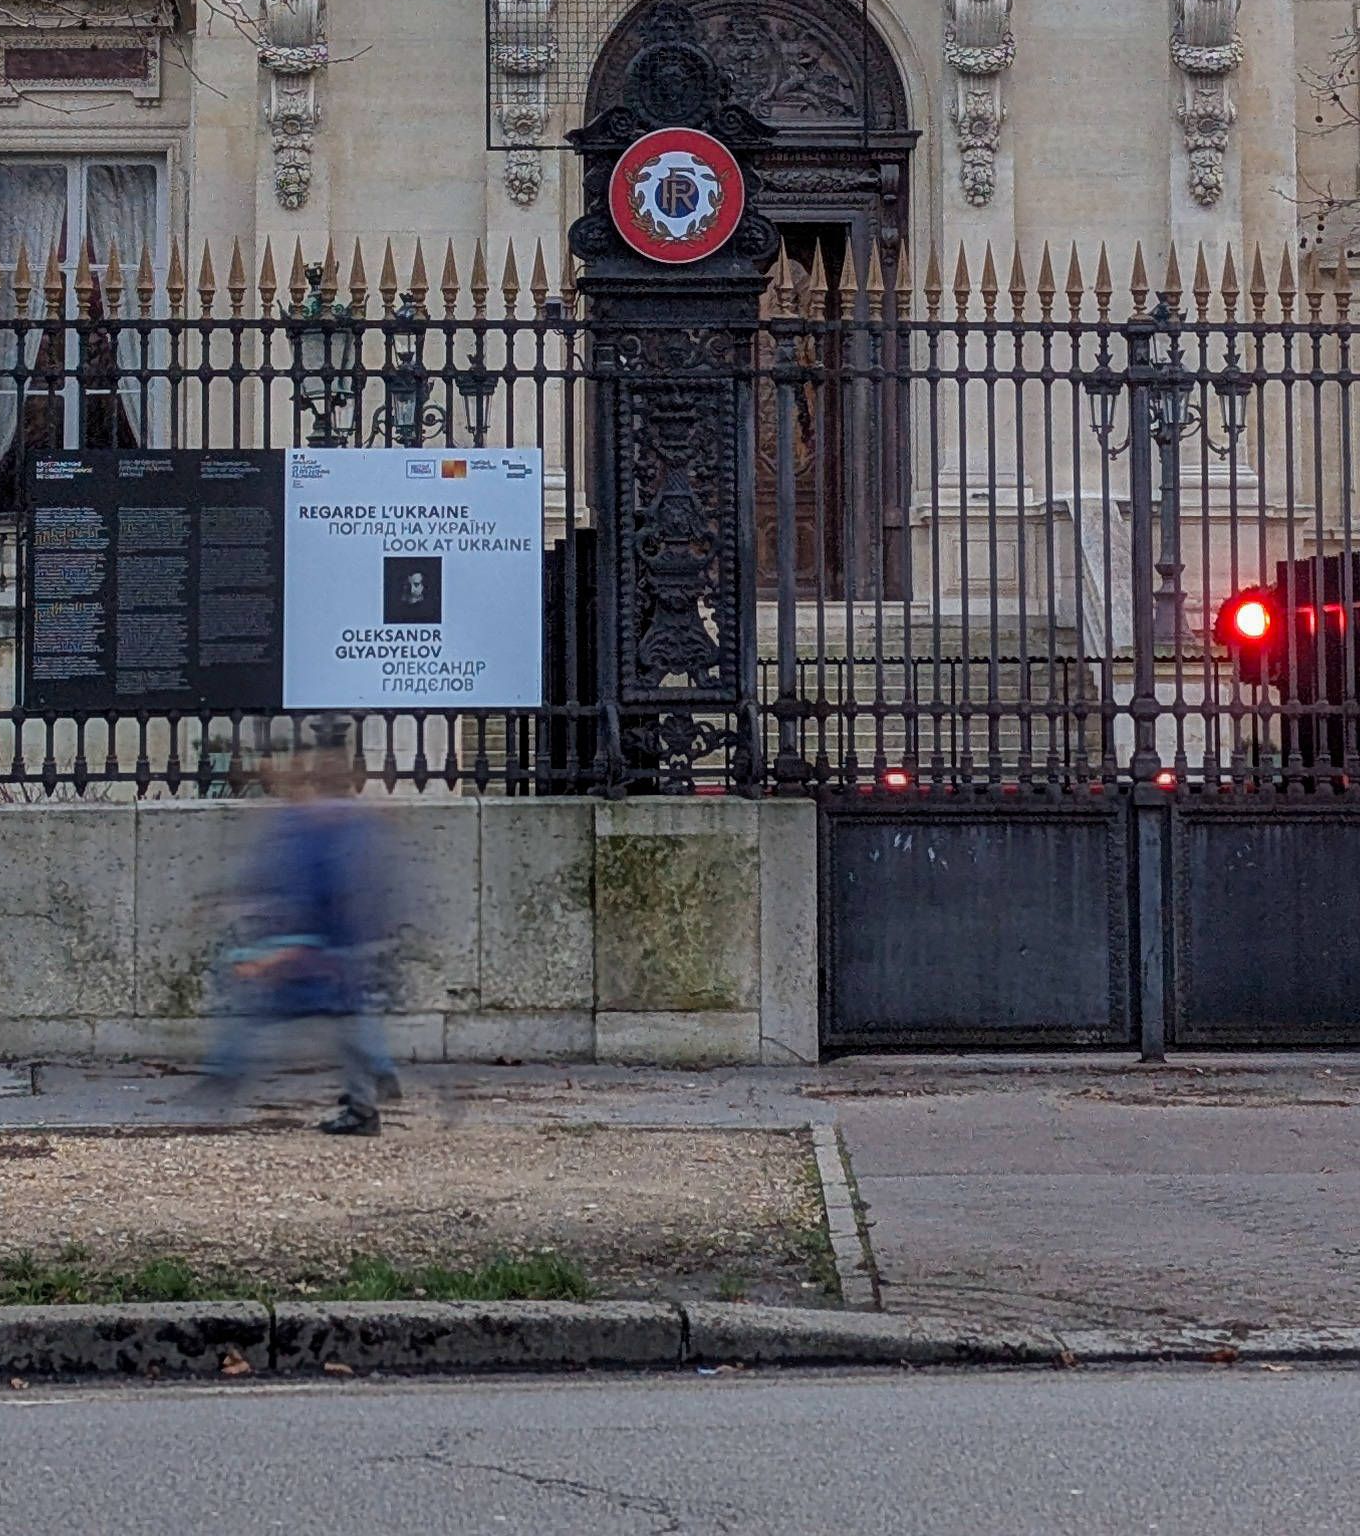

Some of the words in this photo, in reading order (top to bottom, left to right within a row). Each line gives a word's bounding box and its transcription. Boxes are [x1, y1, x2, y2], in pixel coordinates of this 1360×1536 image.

[299, 506, 375, 519] REGARDE
[382, 506, 469, 519] L'UKRAINE
[329, 521, 396, 536] ПОГЛЯД
[401, 522, 423, 535] НА
[428, 519, 497, 535] УКРАЇНУ
[382, 539, 428, 552] LOOK
[433, 539, 453, 552] AT
[458, 539, 532, 552] UKRAINE
[342, 629, 442, 642] OLEKSANDR
[335, 645, 442, 659] GLYADYELOV
[382, 661, 486, 676] ОЛЕКСАНДР
[382, 678, 474, 694] ГЛЯДЄЛОВ
